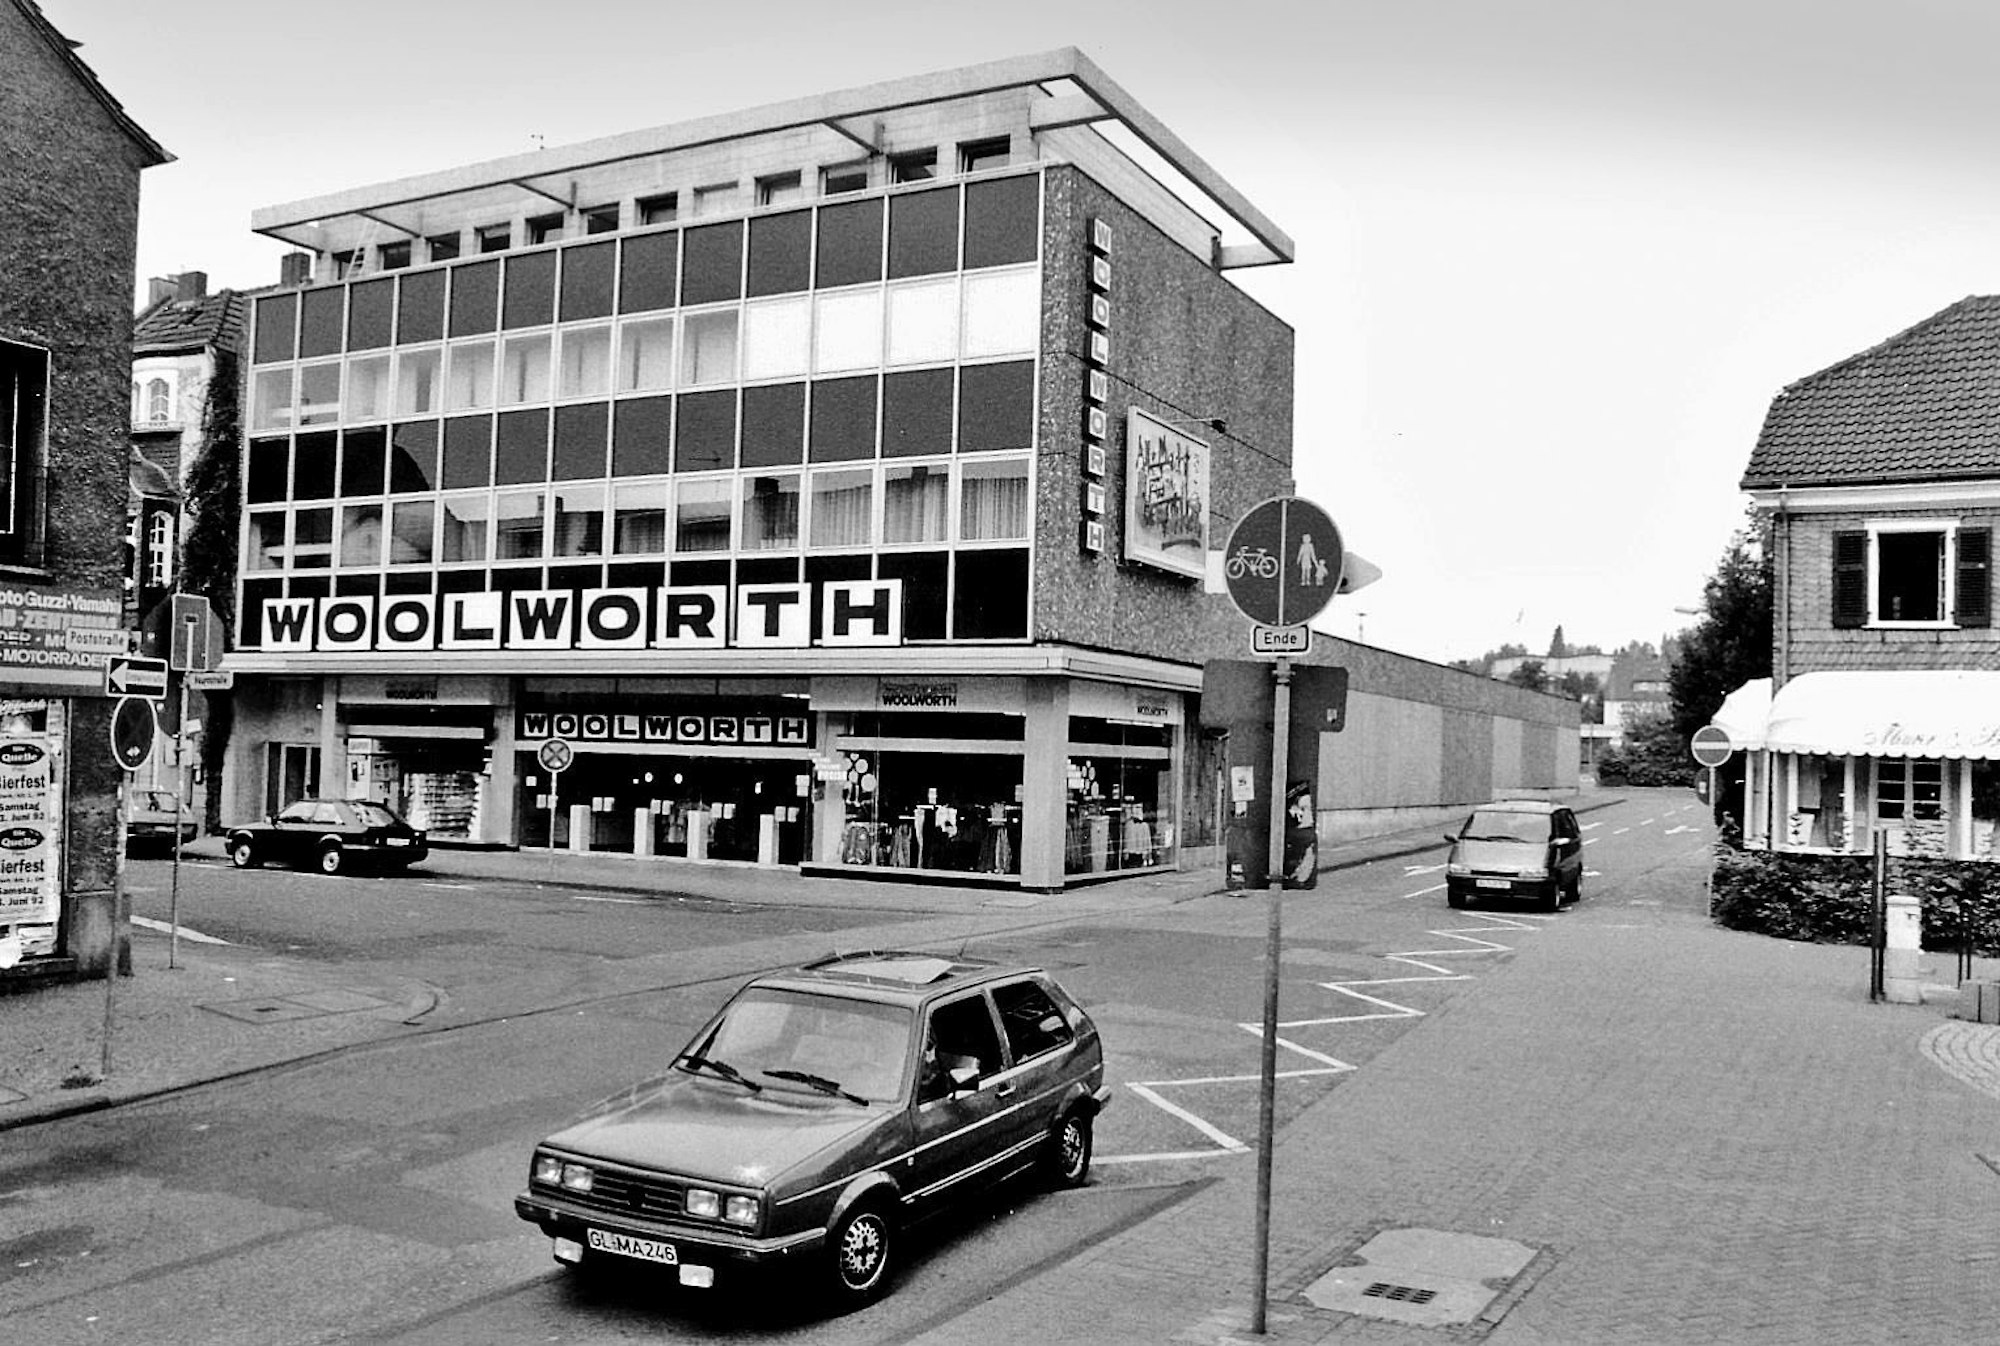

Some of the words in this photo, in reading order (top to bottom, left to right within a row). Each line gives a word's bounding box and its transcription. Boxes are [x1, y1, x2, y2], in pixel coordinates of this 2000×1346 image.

[1088, 219, 1111, 551] WOOLWORTH
[0, 590, 23, 607] oto
[266, 588, 890, 643] WOOLWORTH
[1264, 632, 1297, 645] Ende
[882, 694, 957, 707] WOOLWORTH
[525, 715, 805, 740] WOOLWORTH
[0, 859, 44, 874] ierfest
